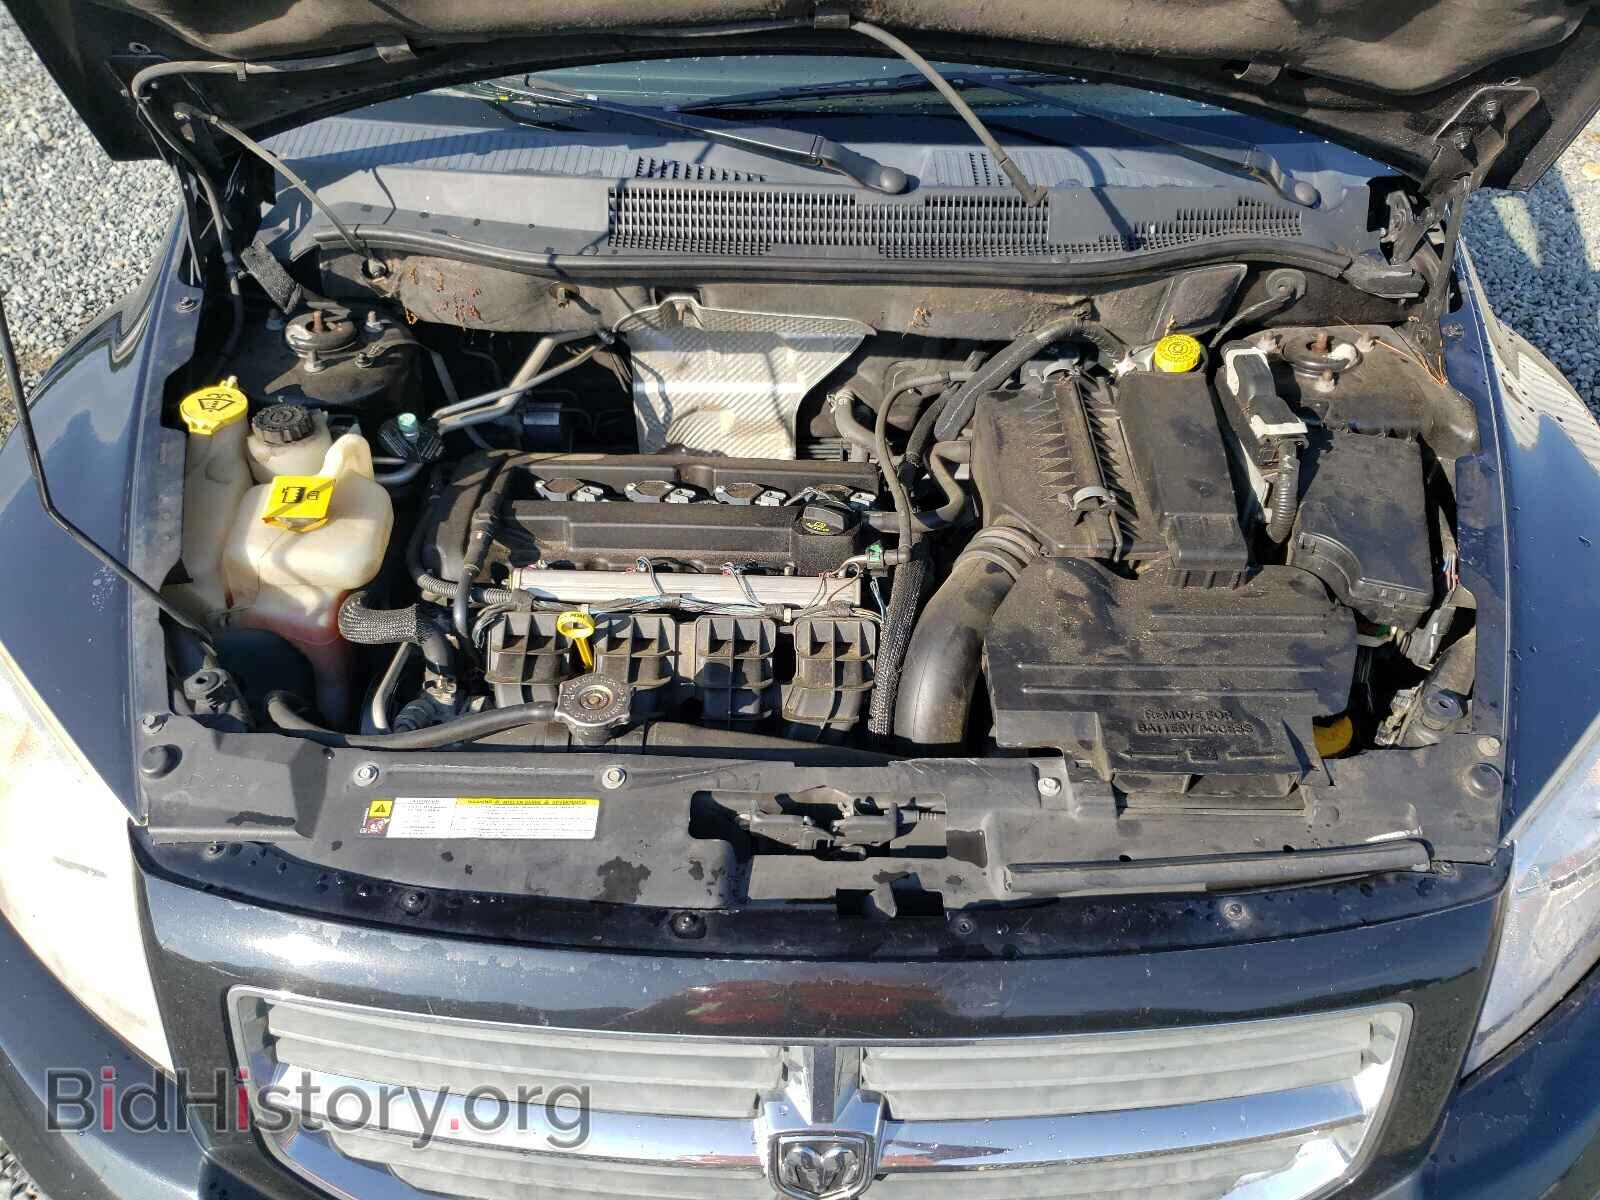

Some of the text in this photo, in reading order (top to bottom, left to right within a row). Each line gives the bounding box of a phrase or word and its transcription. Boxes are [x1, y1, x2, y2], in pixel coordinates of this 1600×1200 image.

[1144, 708, 1233, 722] REMOVE FOR
[1137, 721, 1255, 735] BATTERY ACCESS
